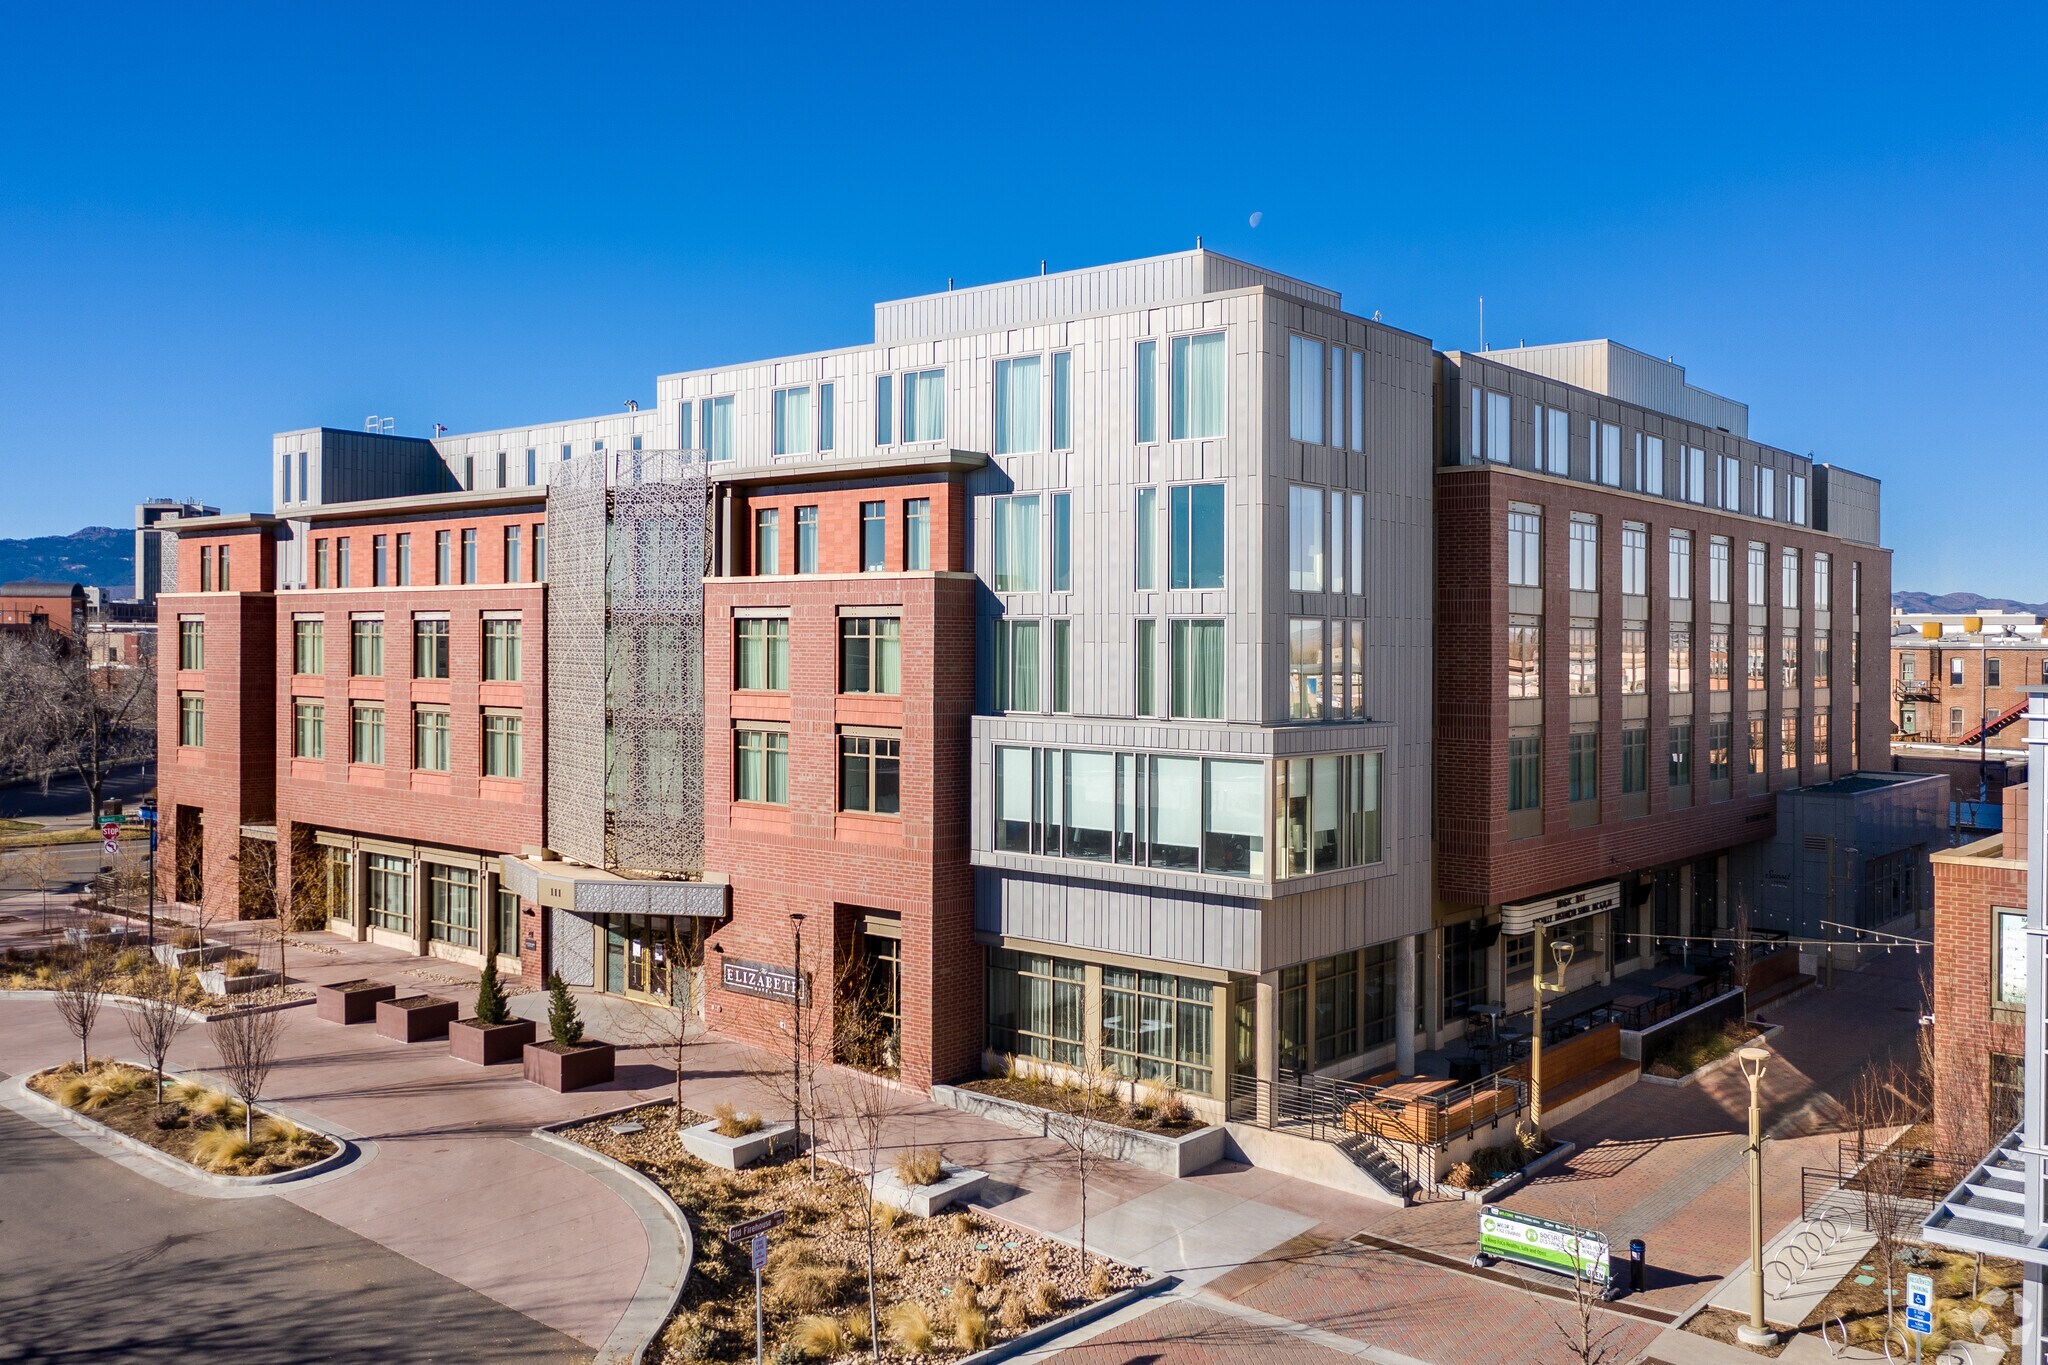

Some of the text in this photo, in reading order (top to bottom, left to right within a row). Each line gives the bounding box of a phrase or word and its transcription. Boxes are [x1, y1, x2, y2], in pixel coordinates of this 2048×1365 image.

[550, 888, 561, 897] 111
[731, 1228, 742, 1239] Old
[744, 1220, 772, 1234] Firehouse
